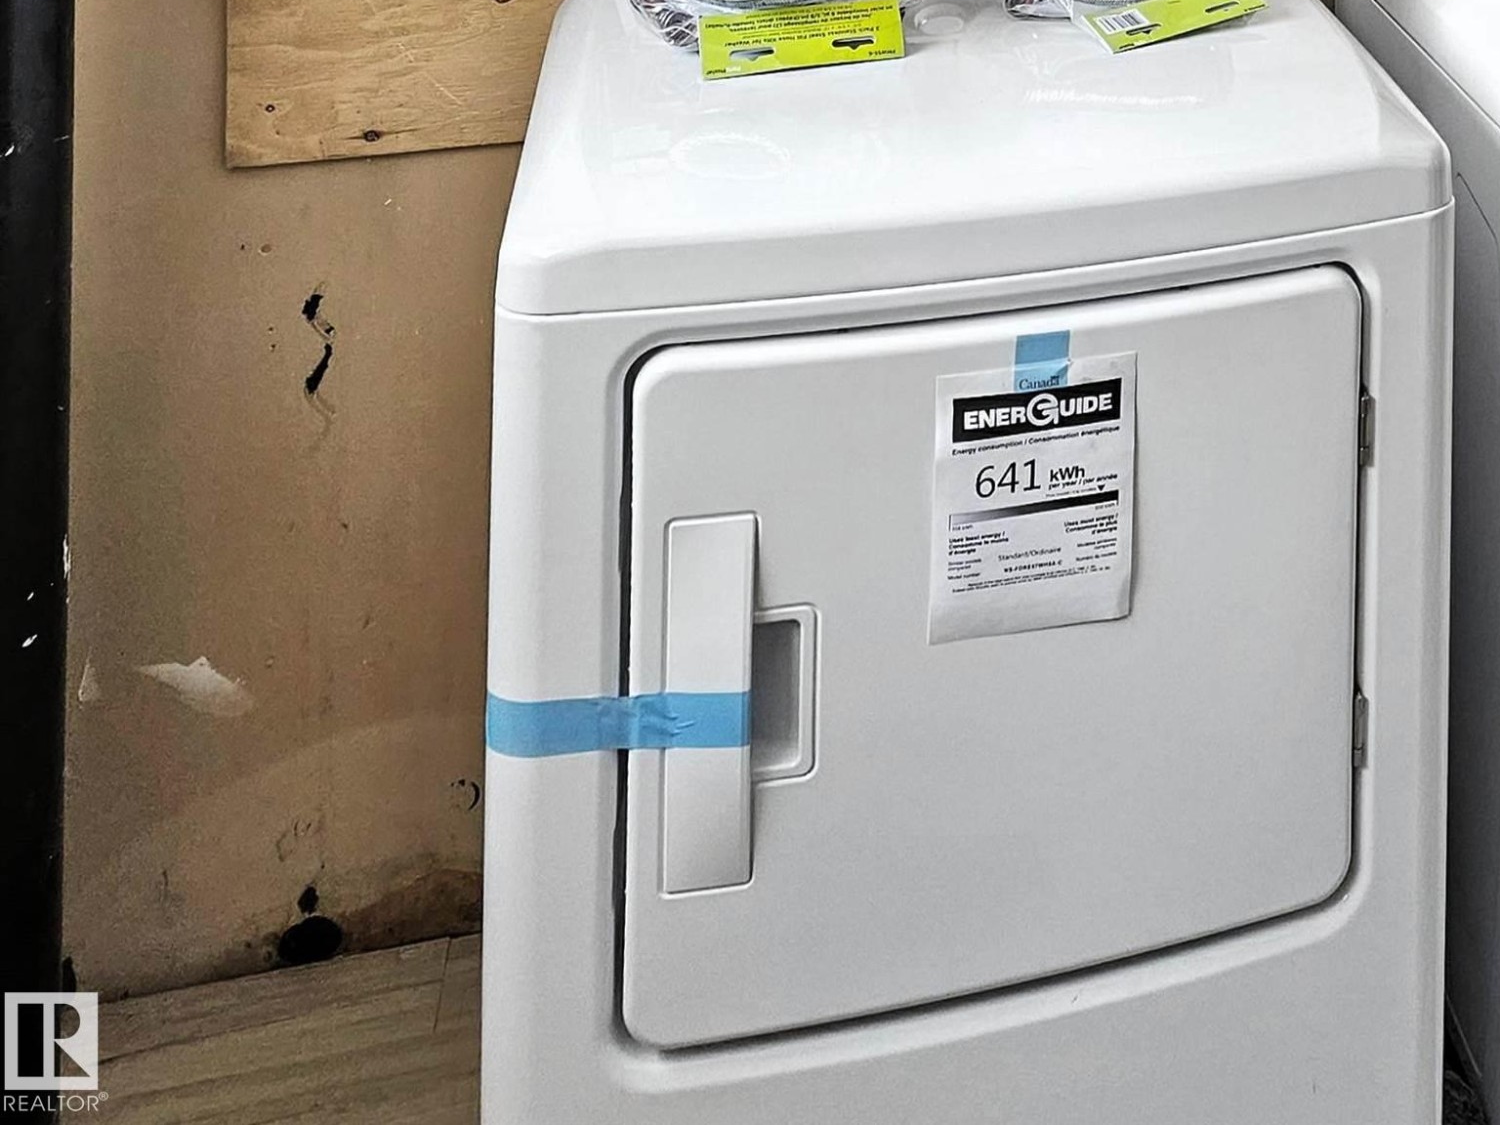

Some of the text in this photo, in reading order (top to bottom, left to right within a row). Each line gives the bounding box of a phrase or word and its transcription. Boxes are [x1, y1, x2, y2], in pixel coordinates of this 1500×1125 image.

[1018, 376, 1060, 391] Canada
[963, 393, 1113, 431] ENERGUIDE
[952, 447, 976, 456] Energy
[978, 440, 1023, 452] consumption
[1028, 431, 1079, 445] Consommation
[975, 458, 1041, 498] 641
[1048, 482, 1060, 491] per
[1062, 480, 1077, 489] year
[1083, 477, 1095, 485] par
[1050, 466, 1085, 483] kWh
